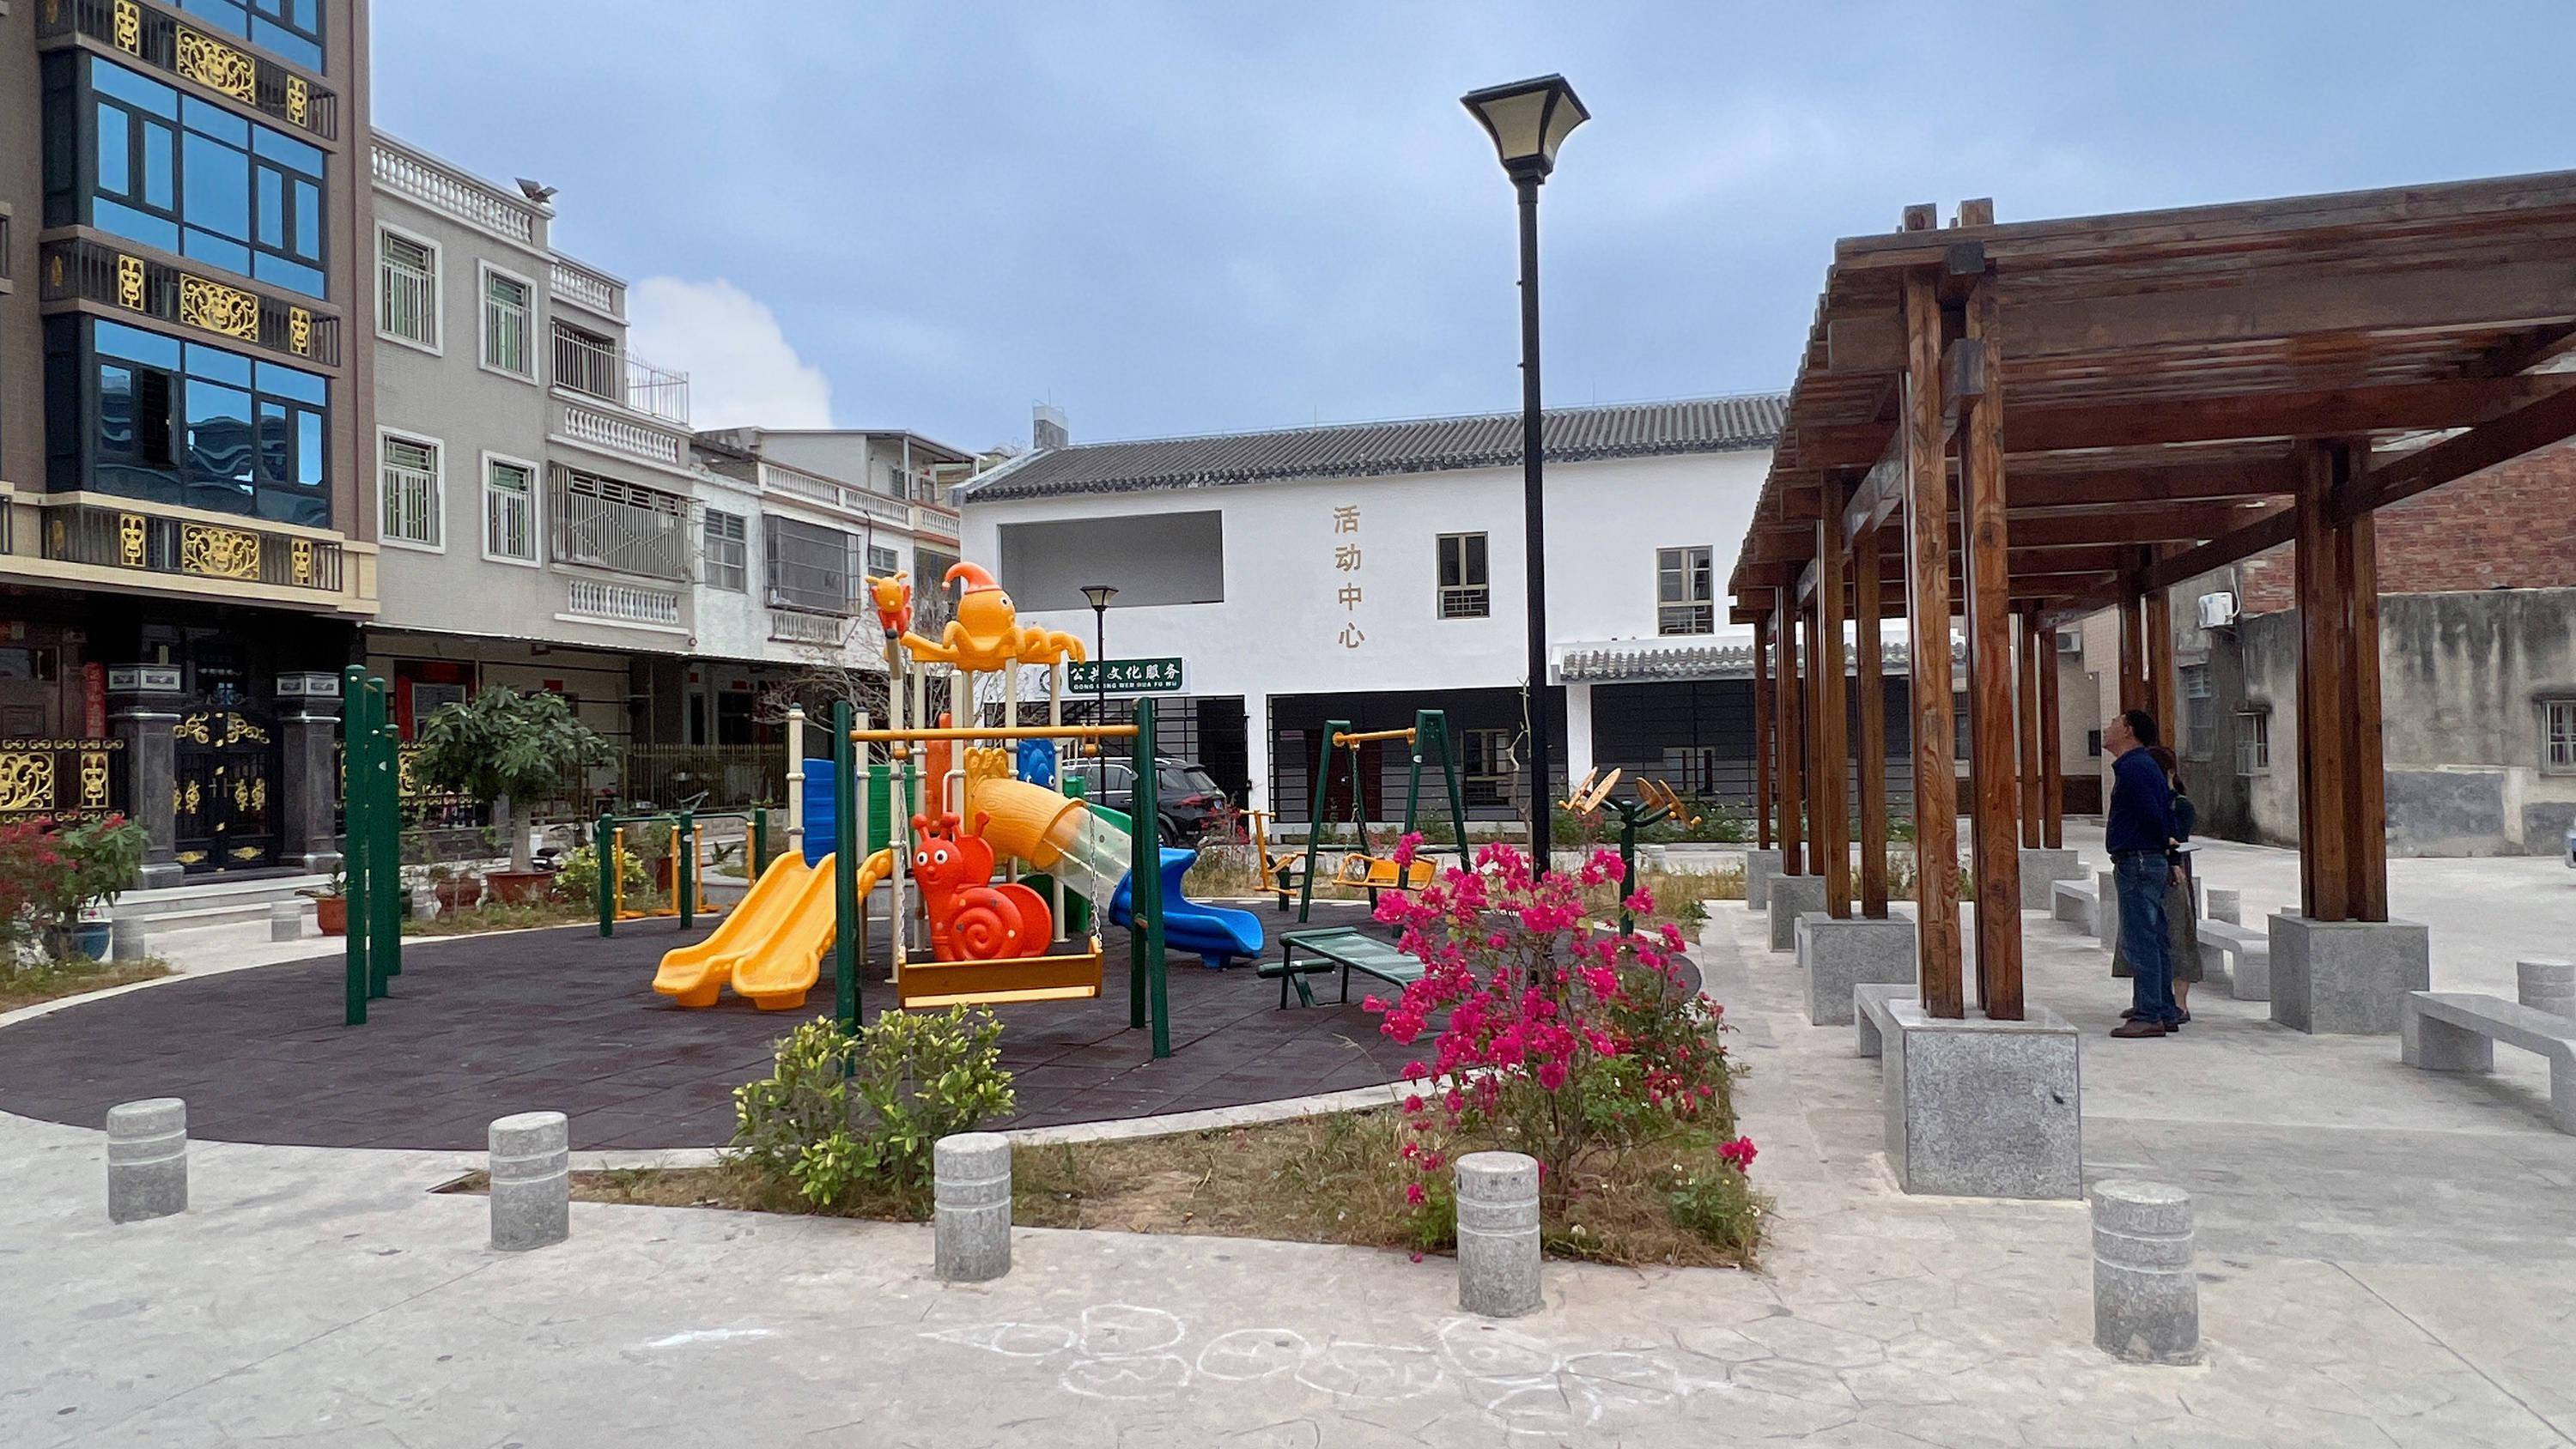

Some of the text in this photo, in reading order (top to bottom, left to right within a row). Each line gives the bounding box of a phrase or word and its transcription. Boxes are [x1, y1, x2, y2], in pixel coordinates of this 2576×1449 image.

[1333, 505, 1365, 649] 活动中心
[1070, 662, 1181, 682] 公共文化服务
